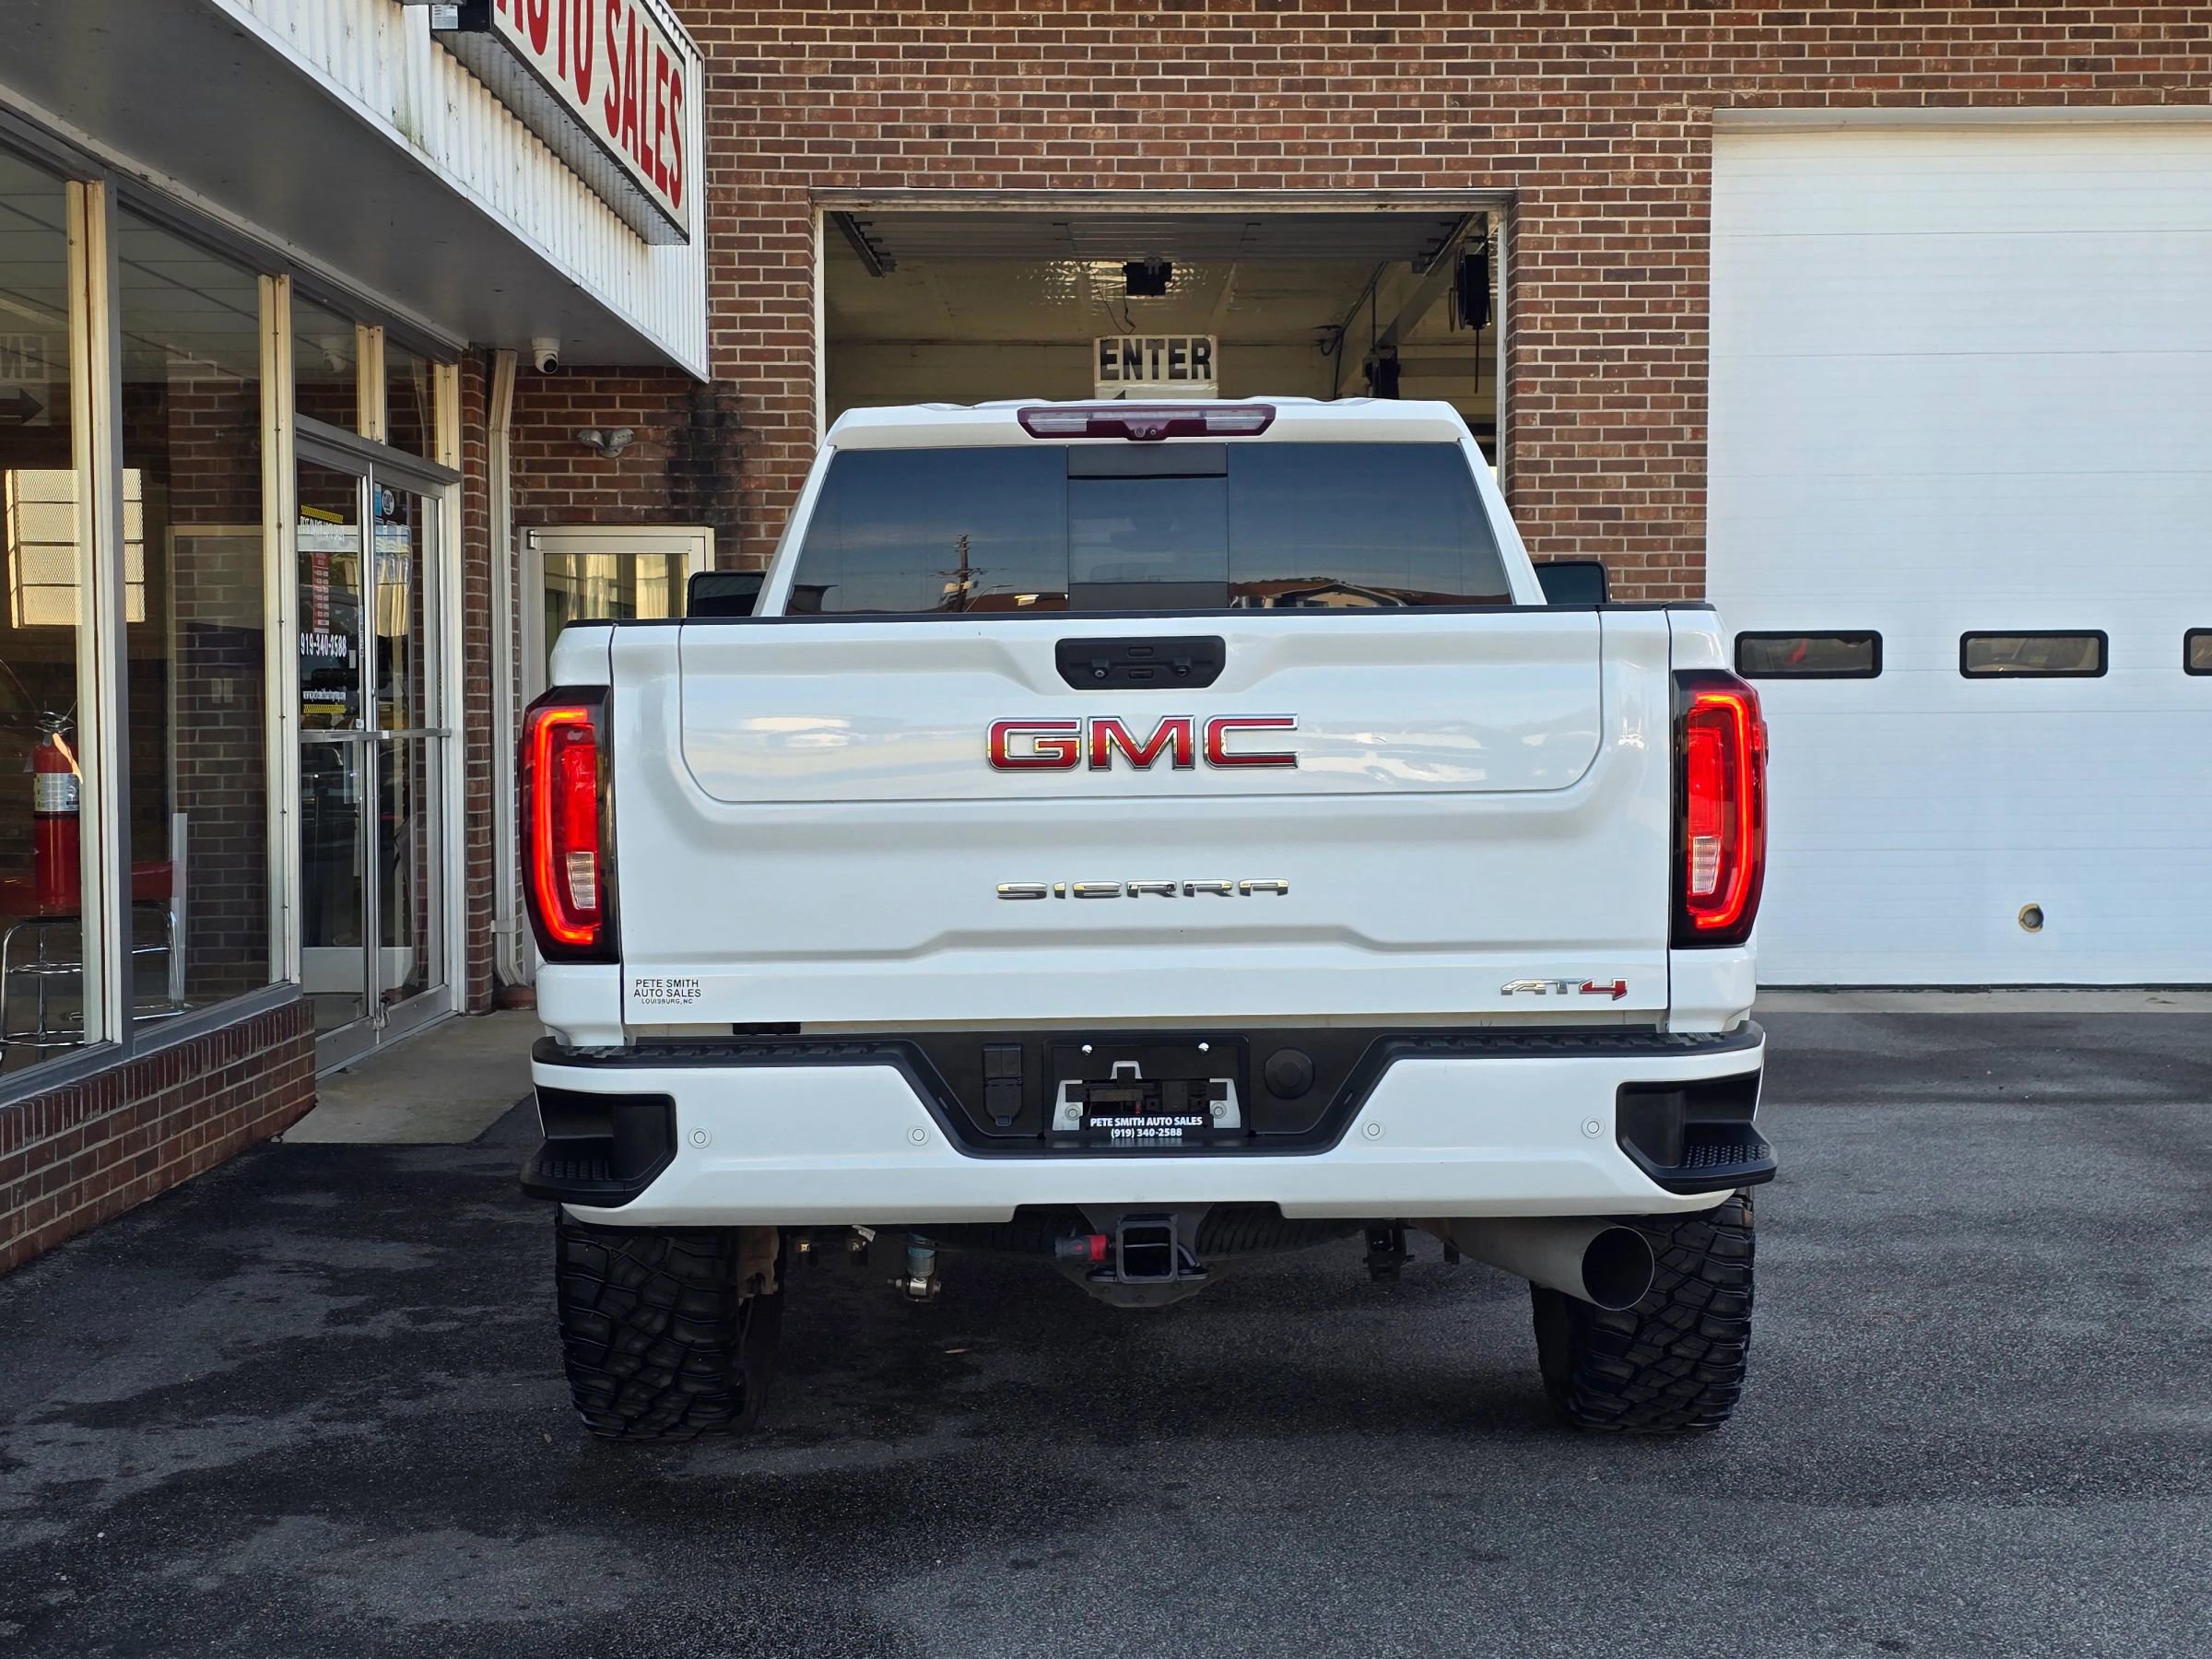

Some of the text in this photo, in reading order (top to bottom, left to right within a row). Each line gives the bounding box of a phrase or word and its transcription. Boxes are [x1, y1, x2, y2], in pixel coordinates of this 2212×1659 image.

[497, 0, 683, 210] TO SALES
[1100, 338, 1212, 381] ENTER
[300, 632, 347, 657] 919-340-2588
[986, 713, 1299, 772] GMC
[996, 879, 1288, 900] SIERRA
[633, 988, 701, 997] AUTO SALES
[635, 979, 699, 988] PETE SMITH
[1500, 977, 1629, 1002] AT4
[1090, 1116, 1204, 1127] PETE SMITH AUTO SALES
[1111, 1128, 1182, 1139] (919) 340-2588
